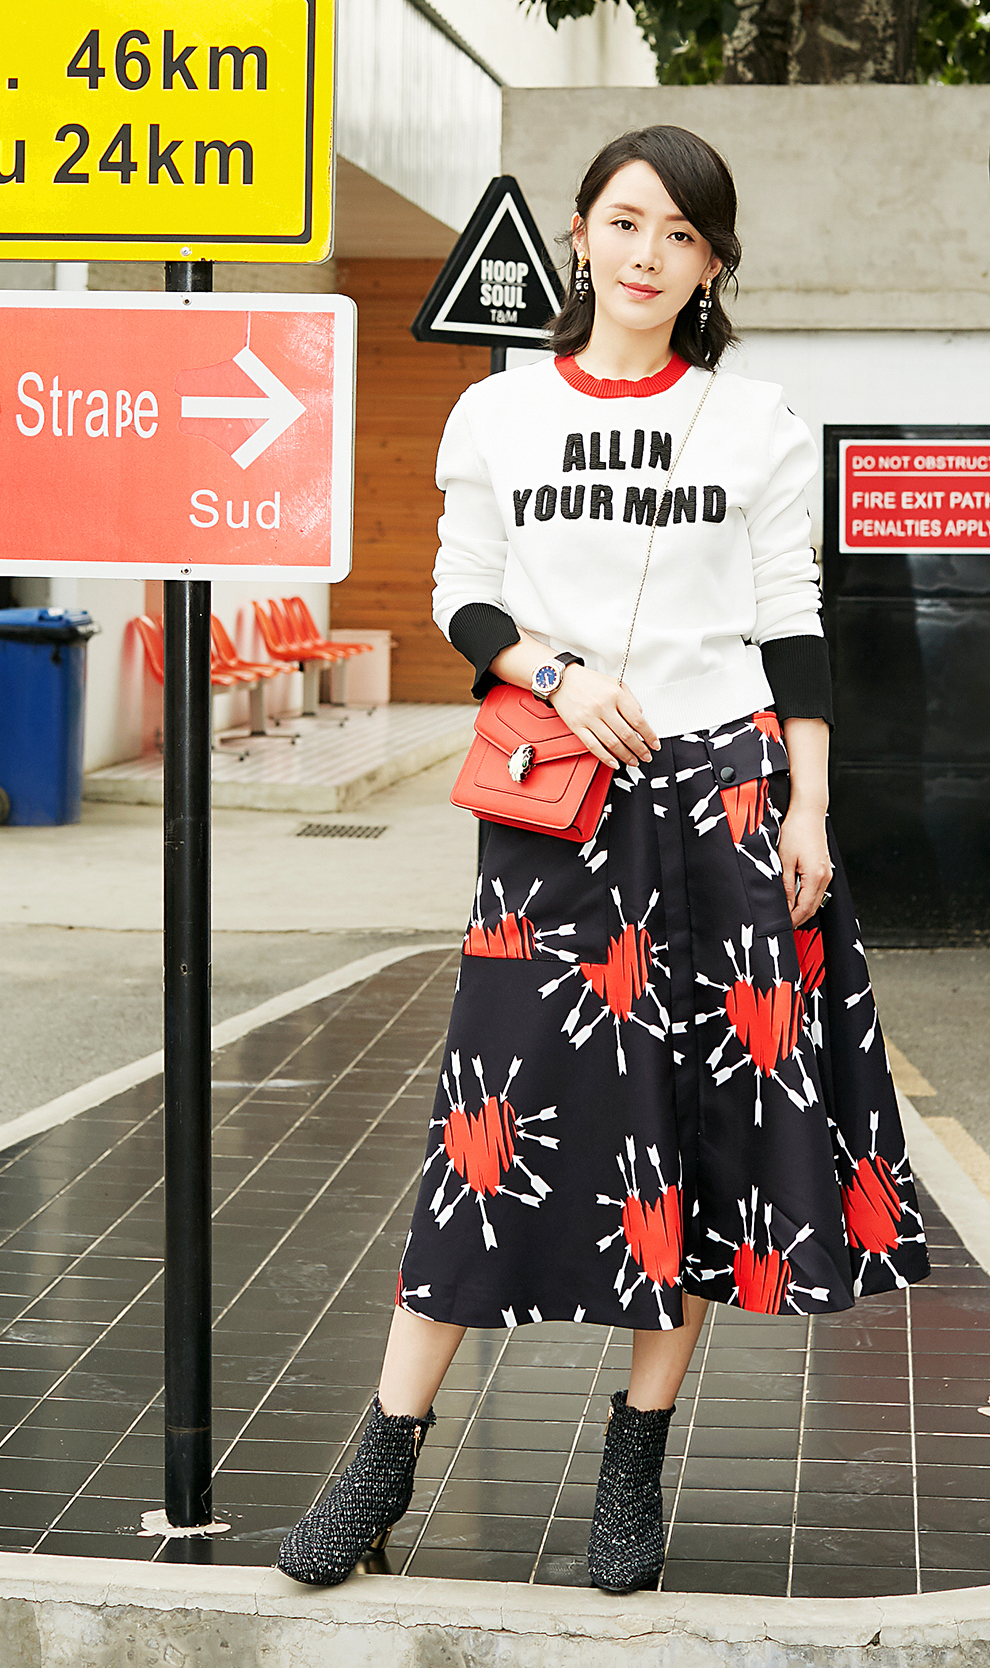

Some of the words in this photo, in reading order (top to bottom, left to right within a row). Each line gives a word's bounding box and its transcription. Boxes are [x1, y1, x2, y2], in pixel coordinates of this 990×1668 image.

[66, 29, 267, 91] 46km
[53, 123, 253, 185] 24km
[480, 258, 529, 284] HOOP
[479, 283, 527, 309] SOUL
[489, 309, 518, 324] T&M
[852, 455, 876, 470] DO
[878, 455, 911, 470] NOT
[913, 455, 990, 471] OBSTRUC
[188, 489, 281, 530] Sud
[512, 484, 613, 527] YOUR
[623, 485, 727, 527] MIND
[852, 491, 896, 509] FIRE
[901, 491, 945, 510] EXIT
[852, 519, 942, 537] PENALTIES
